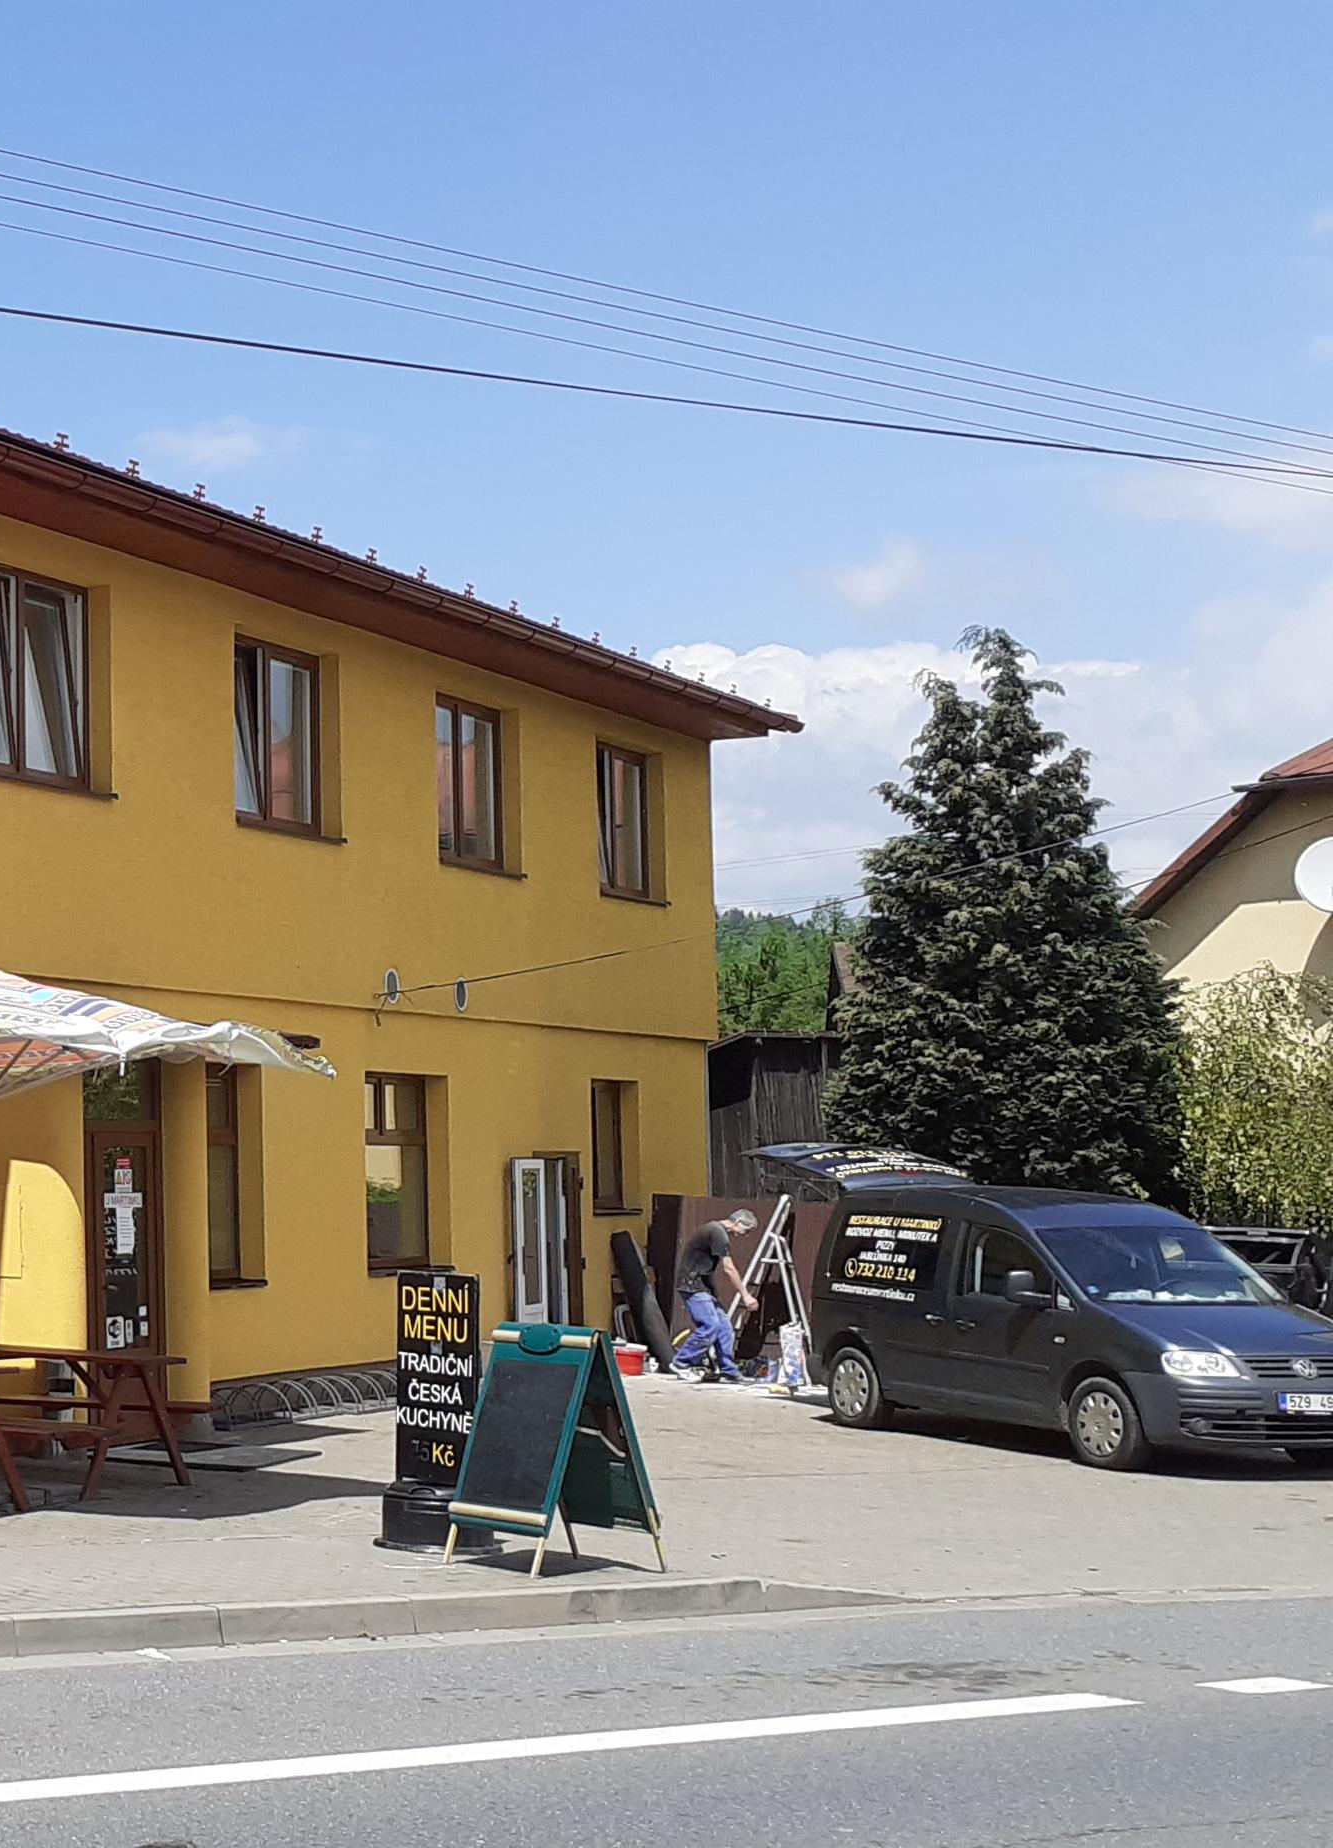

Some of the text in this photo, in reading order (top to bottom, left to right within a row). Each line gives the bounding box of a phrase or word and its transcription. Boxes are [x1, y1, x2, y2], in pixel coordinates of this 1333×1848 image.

[848, 1215, 892, 1226] RESTAURACE
[930, 1233, 938, 1243] A
[857, 1262, 917, 1282] 732 210 114
[401, 1284, 469, 1314] DENNÍ
[404, 1314, 469, 1343] MENU
[398, 1351, 473, 1377] TRADIČNÍ
[408, 1378, 463, 1406] ČESKÁ
[1289, 1395, 1311, 1408] 5Z9
[396, 1405, 473, 1435] KUCHYNĚ
[431, 1441, 455, 1467] Kč
